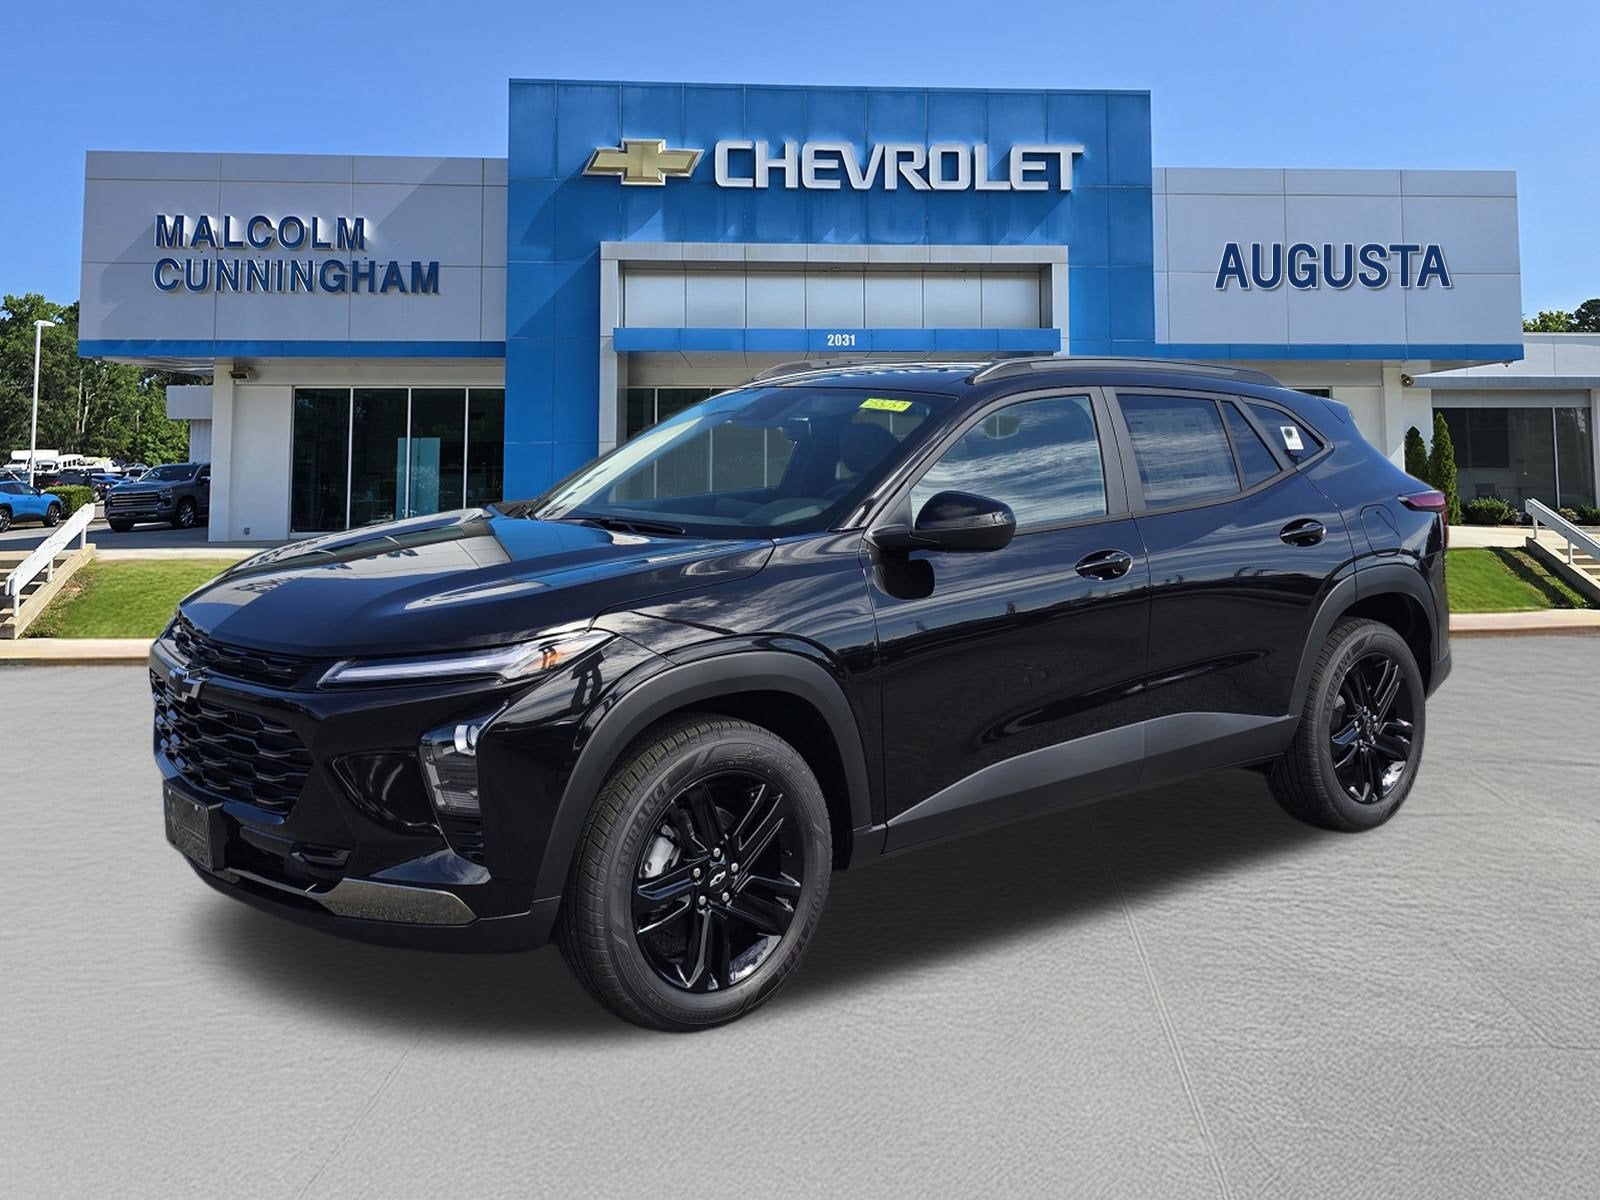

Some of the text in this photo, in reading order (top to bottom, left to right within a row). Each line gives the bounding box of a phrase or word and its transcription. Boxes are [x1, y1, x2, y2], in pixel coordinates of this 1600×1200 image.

[714, 139, 1085, 192] CHEVROLET
[153, 214, 367, 250] MALCOLM
[152, 257, 440, 295] CUNNINGHAM
[1214, 241, 1452, 290] AUGUSTA
[826, 333, 857, 347] 2031
